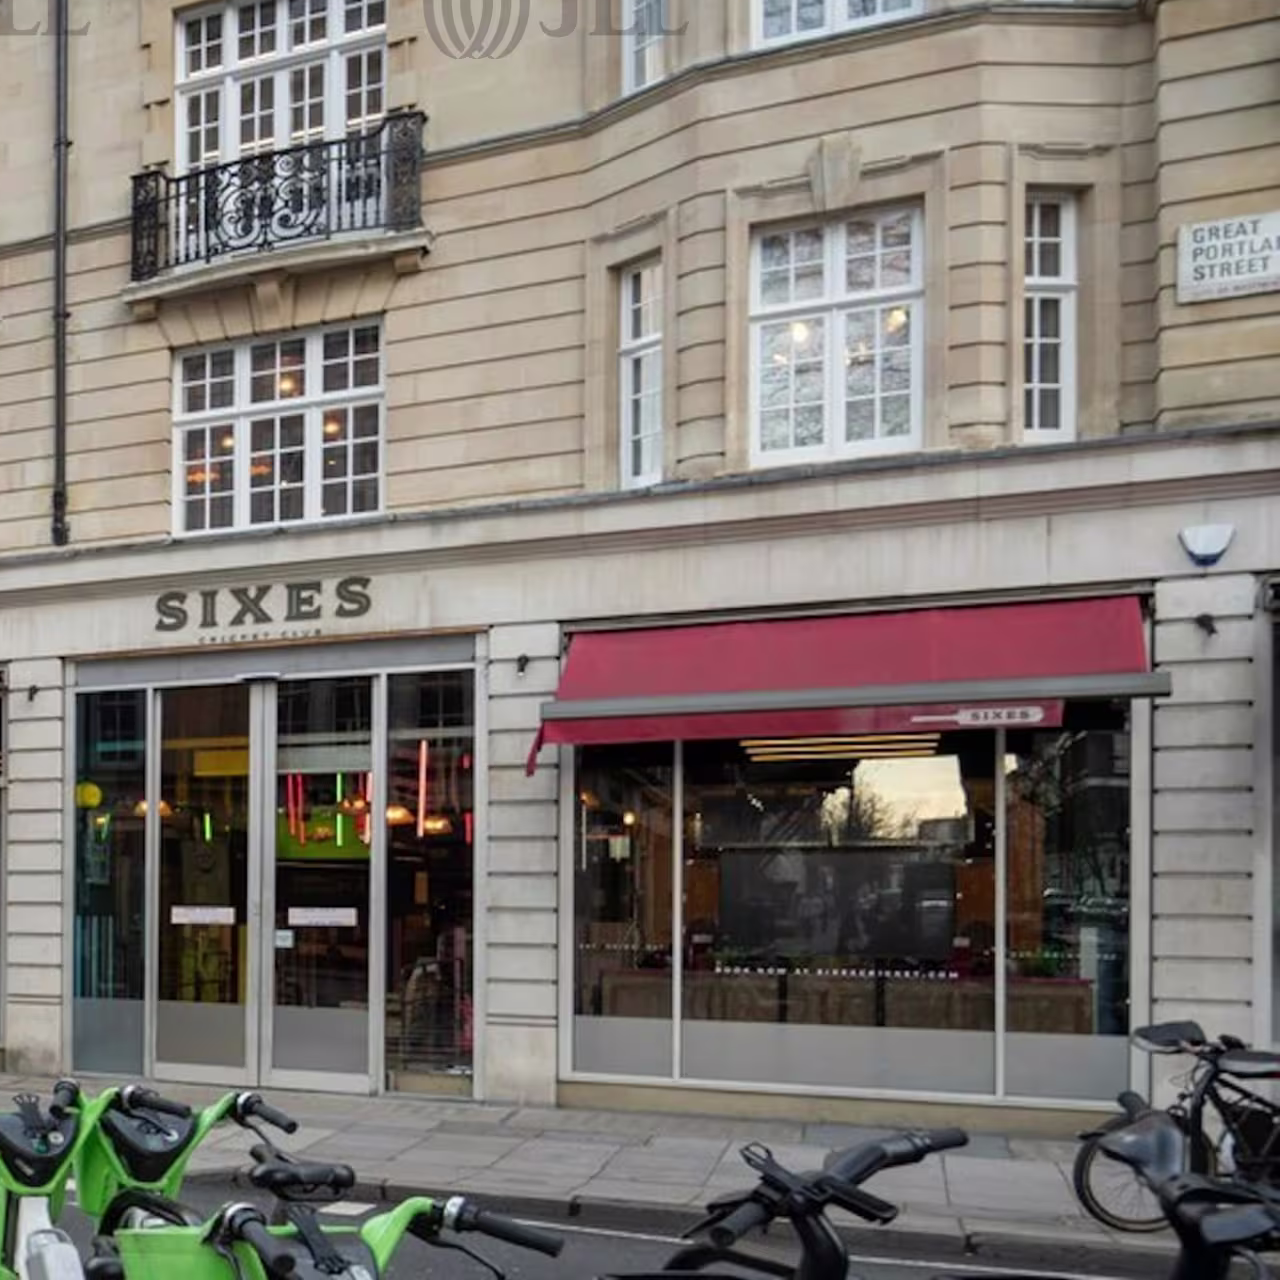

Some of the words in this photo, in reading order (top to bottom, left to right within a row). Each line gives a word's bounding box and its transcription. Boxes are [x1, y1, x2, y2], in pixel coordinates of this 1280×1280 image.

[1191, 219, 1261, 244] GREAT
[1193, 256, 1269, 281] STREET
[154, 576, 372, 632] SIXES
[970, 709, 1031, 722] SIXES
